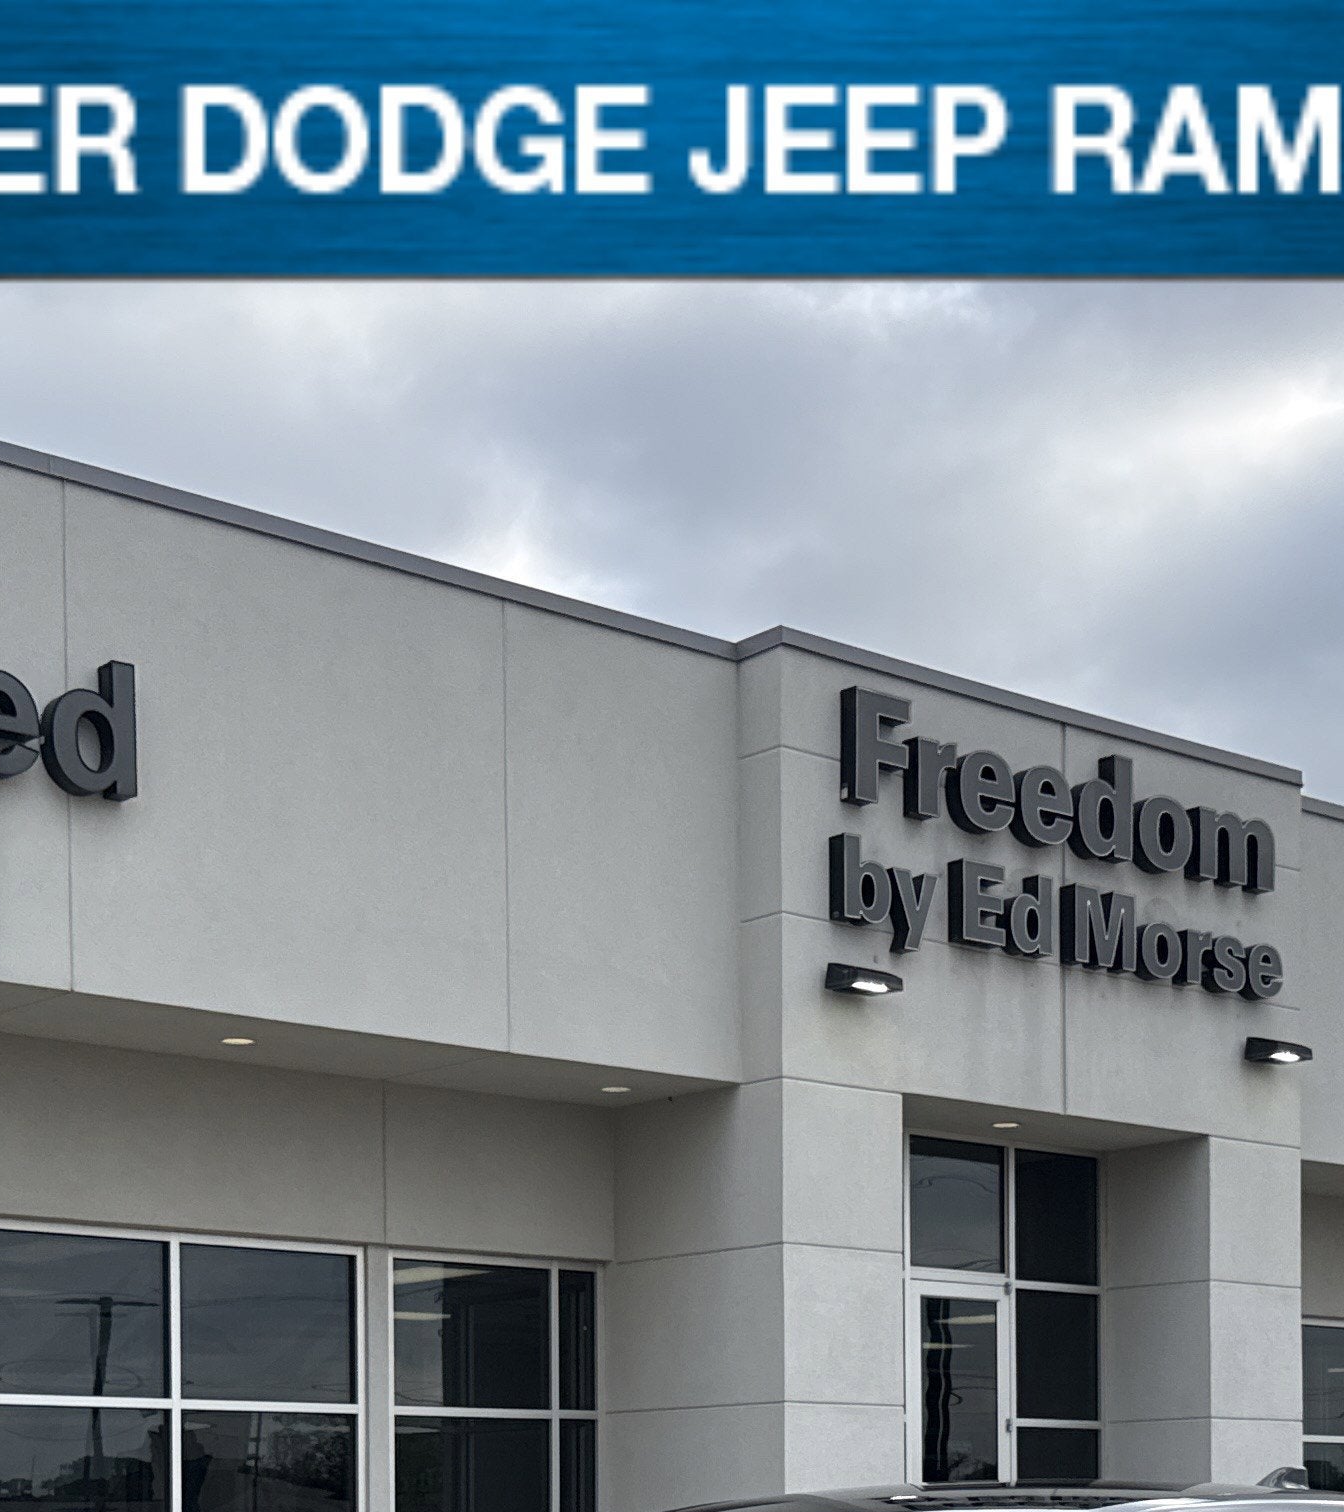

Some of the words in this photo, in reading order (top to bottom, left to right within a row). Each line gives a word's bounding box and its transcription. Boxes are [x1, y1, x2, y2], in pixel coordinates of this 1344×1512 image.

[840, 685, 1276, 894] Freedom
[828, 832, 938, 953] by
[947, 858, 1054, 957] Ed
[1060, 883, 1284, 1001] Morse
